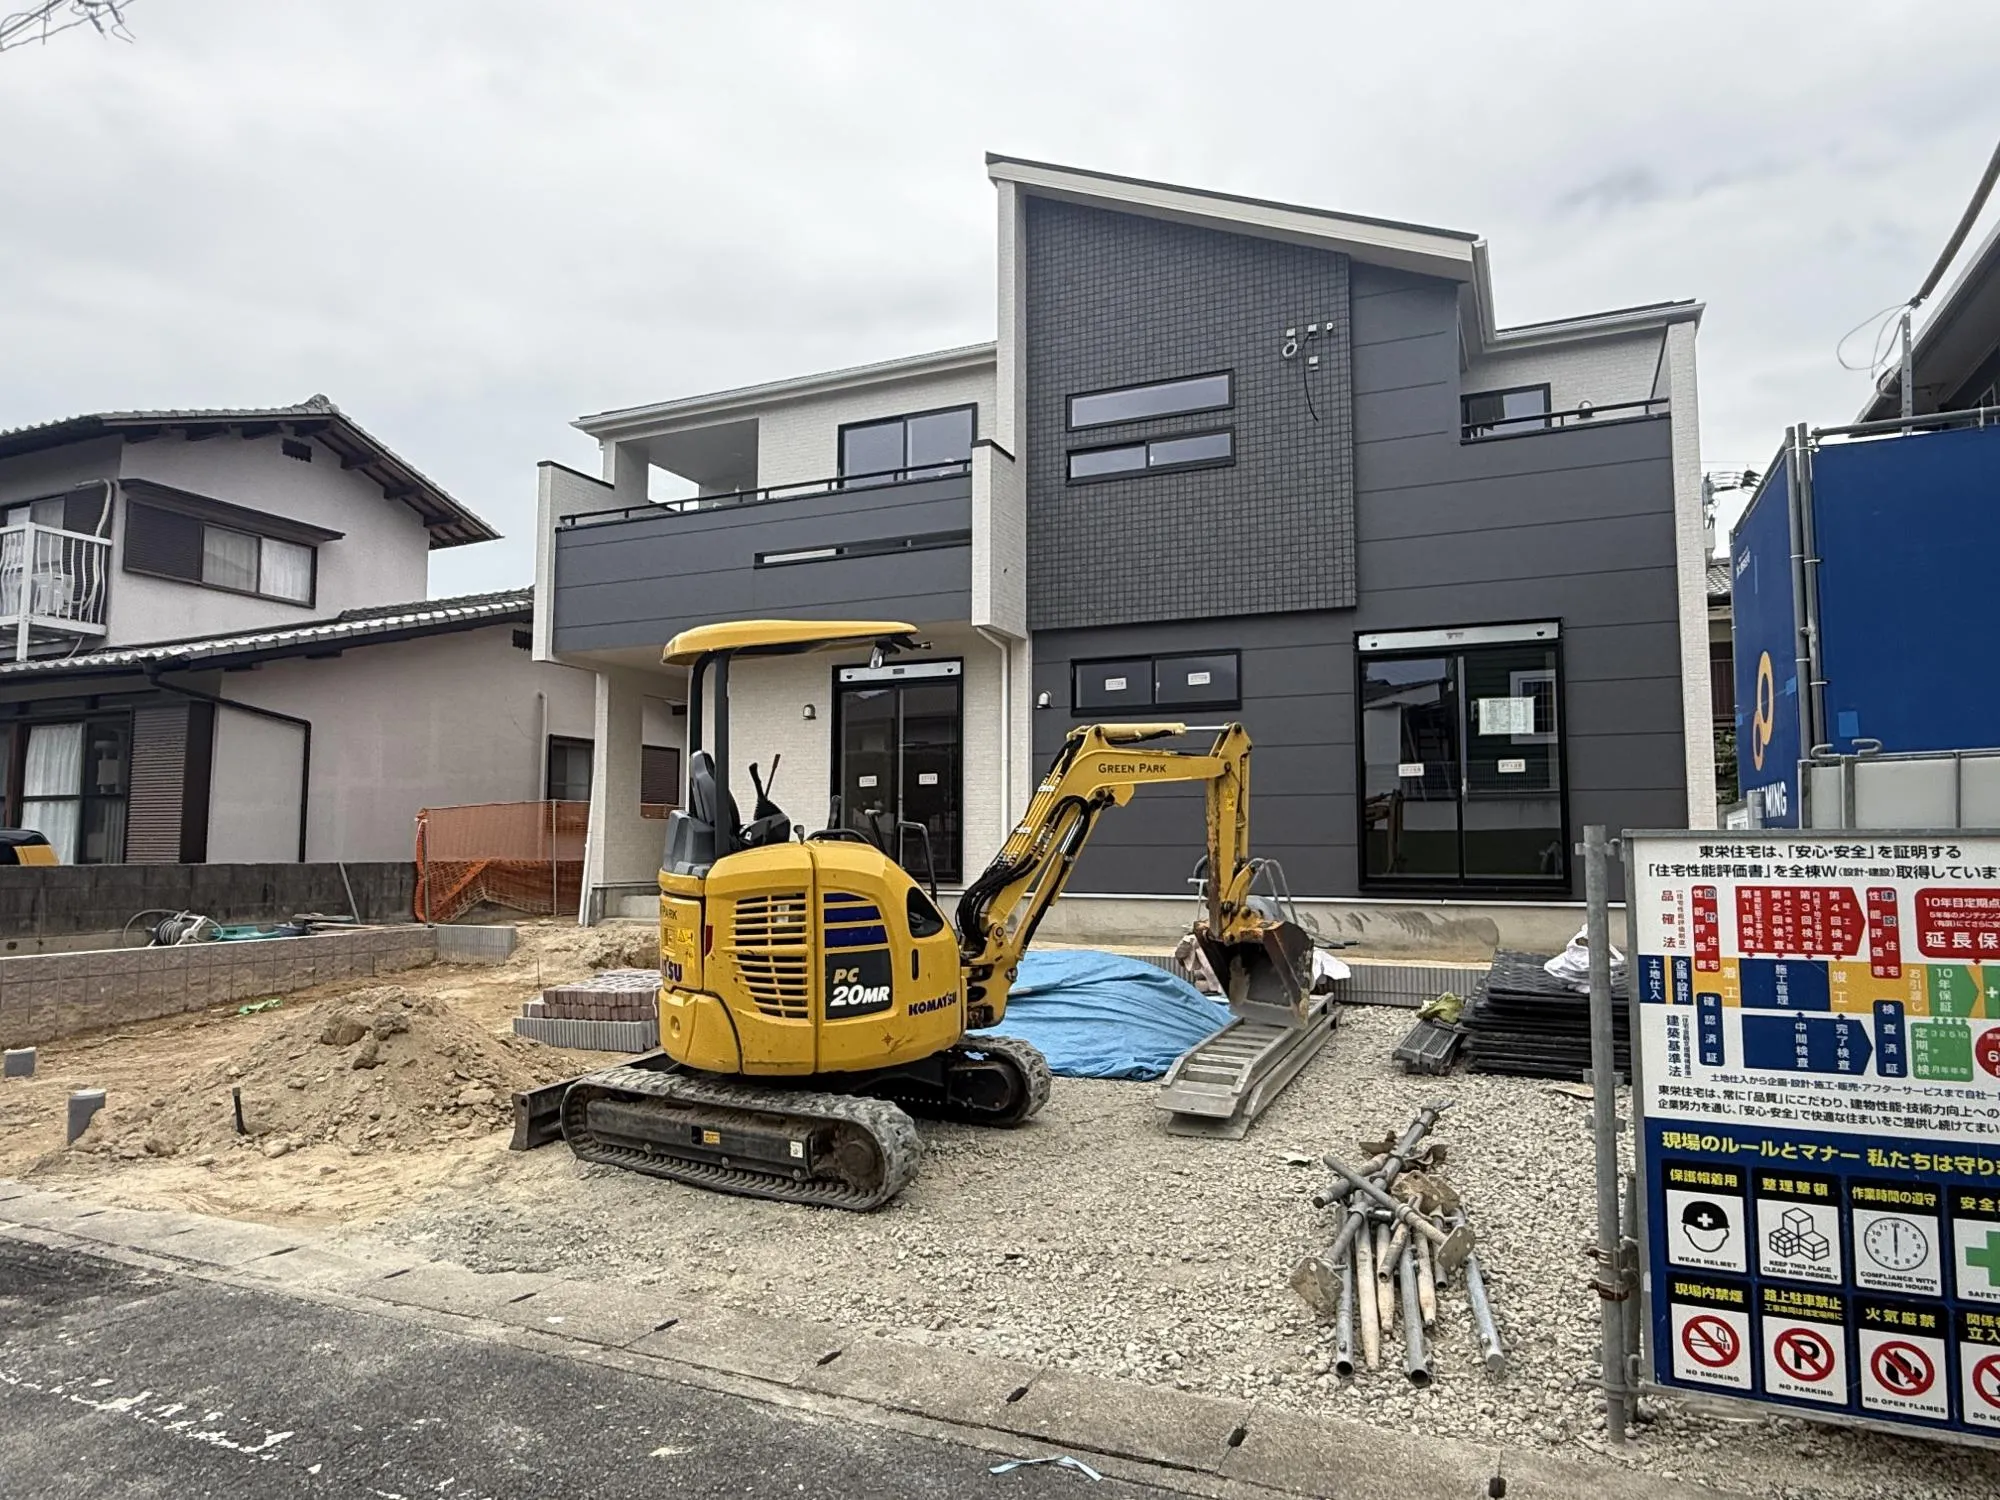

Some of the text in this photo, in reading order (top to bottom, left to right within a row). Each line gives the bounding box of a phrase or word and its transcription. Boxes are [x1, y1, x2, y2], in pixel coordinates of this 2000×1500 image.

[1098, 763, 1167, 774] GREEN PARK
[832, 967, 860, 984] PC
[1649, 958, 1662, 1000] 土地仕入
[1775, 964, 1789, 1006] 施工管理
[830, 984, 890, 1007] 20MR
[1936, 968, 1954, 1013] 10年保証
[908, 990, 957, 1017] KOMATSU
[1795, 1022, 1809, 1068] 中間検査
[1836, 1023, 1850, 1071] 完了検査
[1914, 1027, 1930, 1076] 定期点検
[1710, 1074, 2000, 1101] 土地仕入から企画・設計・施工・販売・アフターサービスまで自社一
[1662, 1131, 1860, 1162] 現場のルールとマナー
[1670, 1168, 1738, 1188] 保護帽着用
[1762, 1178, 1828, 1197] 整理整頓
[1960, 1196, 2000, 1213] 安全
[1677, 1255, 1738, 1268] WEAR HELMET
[1769, 1260, 1788, 1268] KEEP
[1808, 1264, 1832, 1272] PLACE
[1804, 1270, 1838, 1280] ORDERLY
[1860, 1271, 1938, 1285] COMPLIANCE WITH
[1863, 1278, 1935, 1292] WORKING HOURS
[1674, 1282, 1744, 1304] 現場内禁煙
[1764, 1288, 1843, 1310] 路上駐車禁止
[1865, 1307, 1936, 1328] 火気厳禁
[1685, 1368, 1740, 1383] NO SMOKING
[1778, 1383, 1834, 1397] NO PARKING
[1865, 1396, 1946, 1414] NO OPEN FLAMES
[1973, 1411, 1986, 1420] DO
